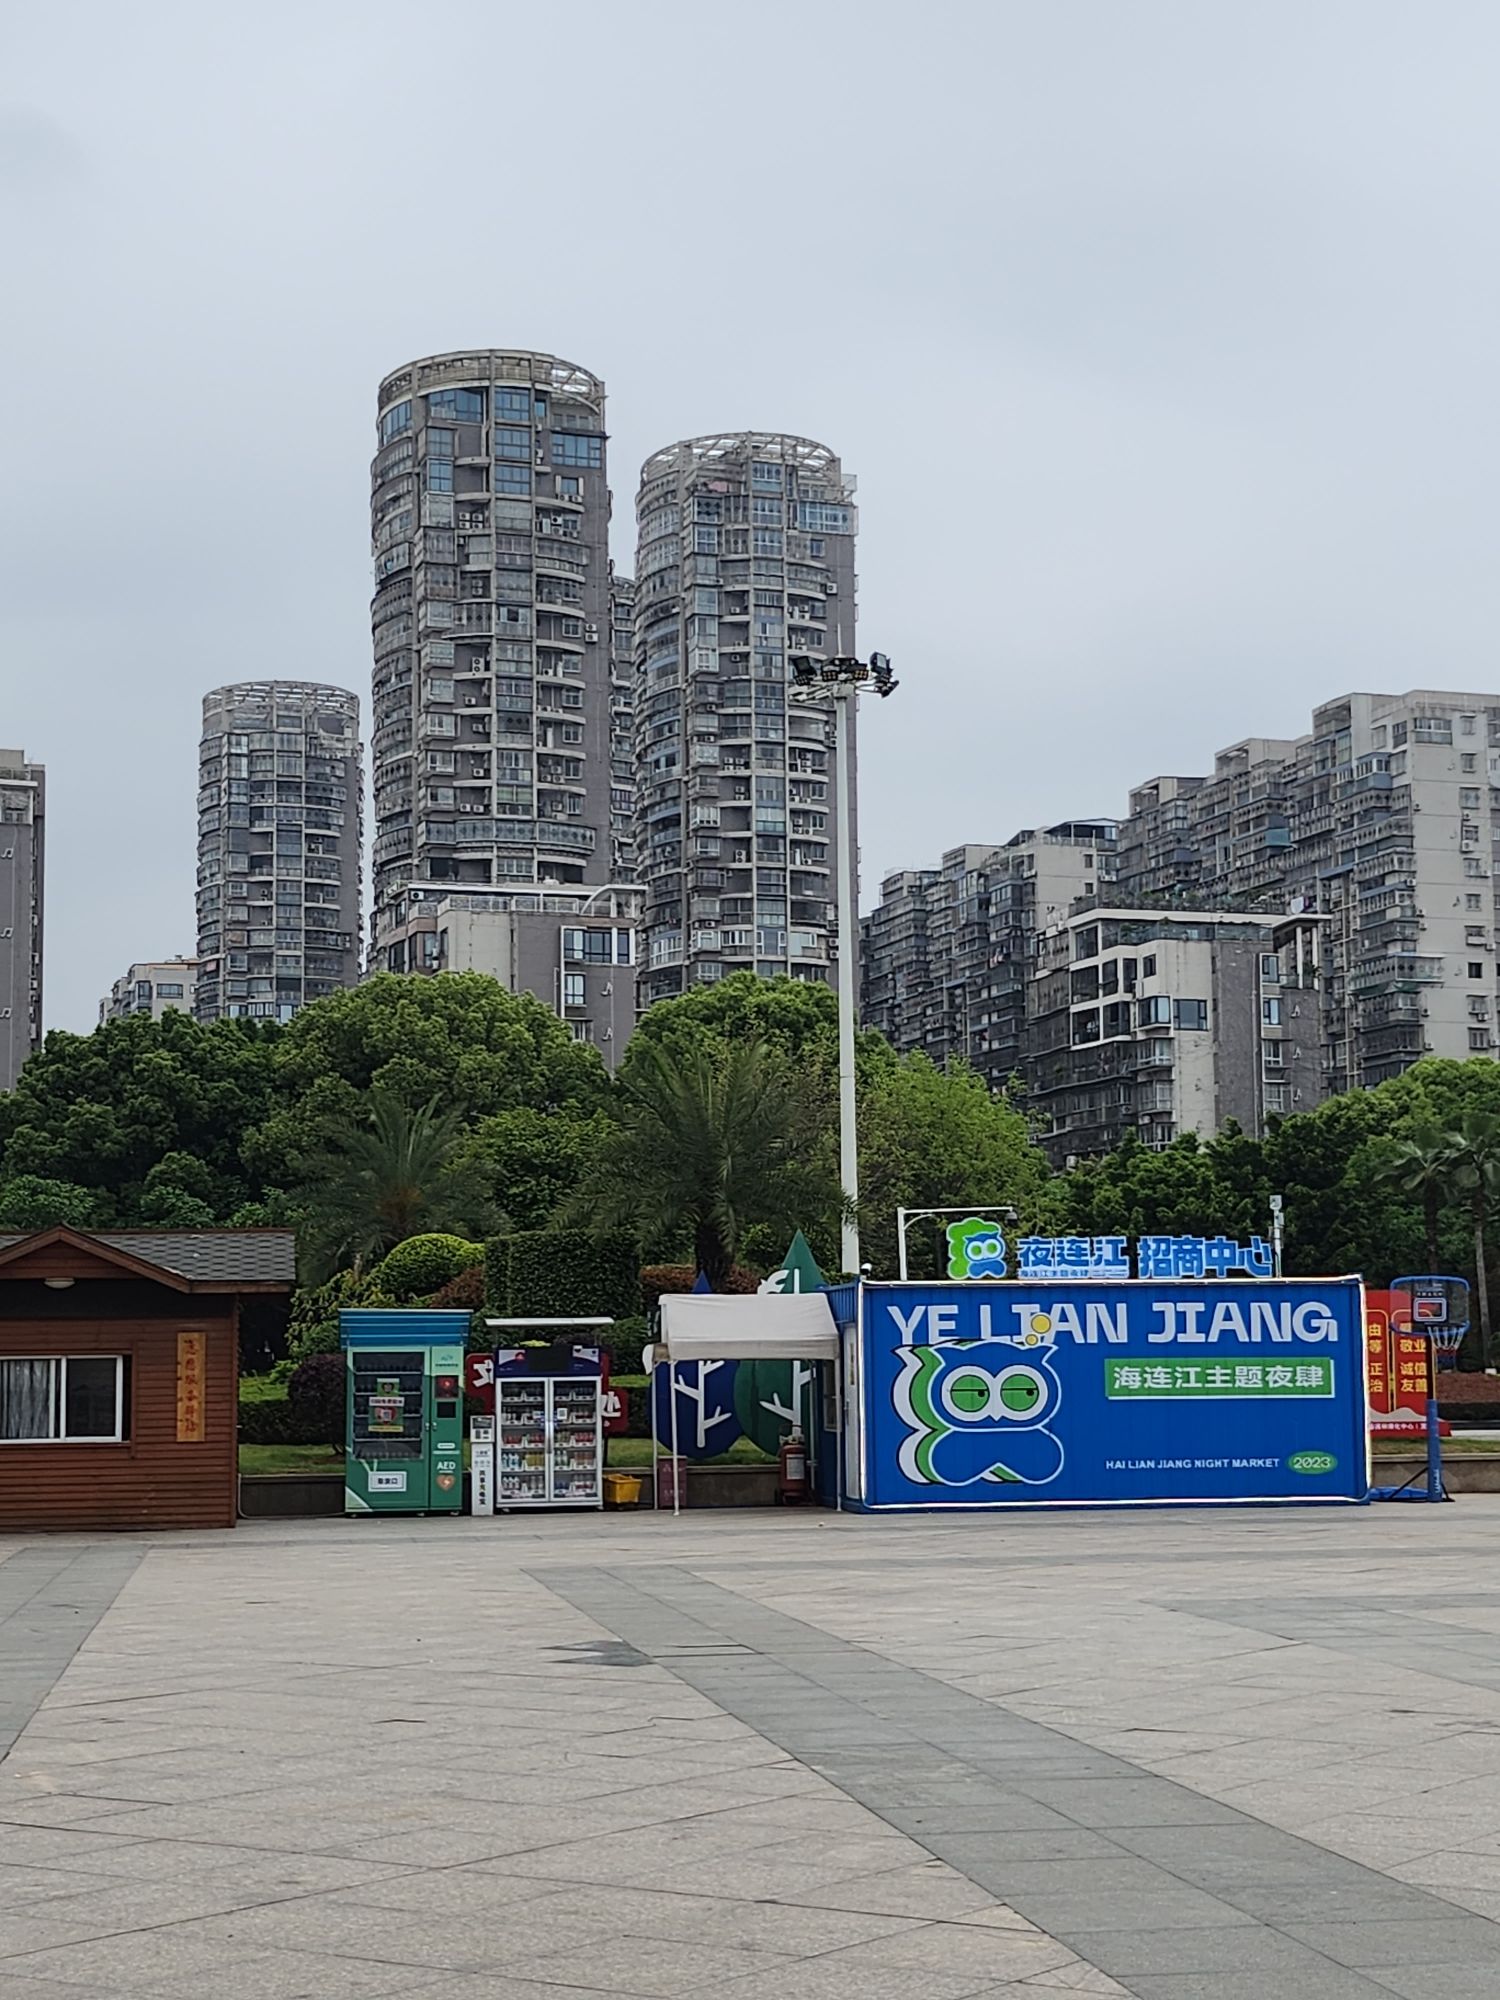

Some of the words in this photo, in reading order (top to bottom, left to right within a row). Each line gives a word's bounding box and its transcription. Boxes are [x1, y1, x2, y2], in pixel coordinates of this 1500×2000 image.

[1018, 1237, 1127, 1267] 夜连江
[1139, 1236, 1273, 1278] 招商中心
[887, 1304, 959, 1345] YE
[980, 1303, 1128, 1344] LIAN
[1148, 1302, 1339, 1343] JIANG
[1400, 1339, 1426, 1353] 敬业
[1400, 1362, 1427, 1376] 诚信
[1113, 1366, 1325, 1390] 海连江主题夜肆
[1400, 1379, 1428, 1393] 友善
[437, 1461, 456, 1470] AED
[1106, 1459, 1126, 1469] HAI
[1128, 1459, 1155, 1469] LIAN
[1157, 1459, 1192, 1468] JIANG
[1194, 1459, 1229, 1468] NIGHT
[1232, 1458, 1280, 1468] MARKET
[1293, 1456, 1331, 1469] 2023
